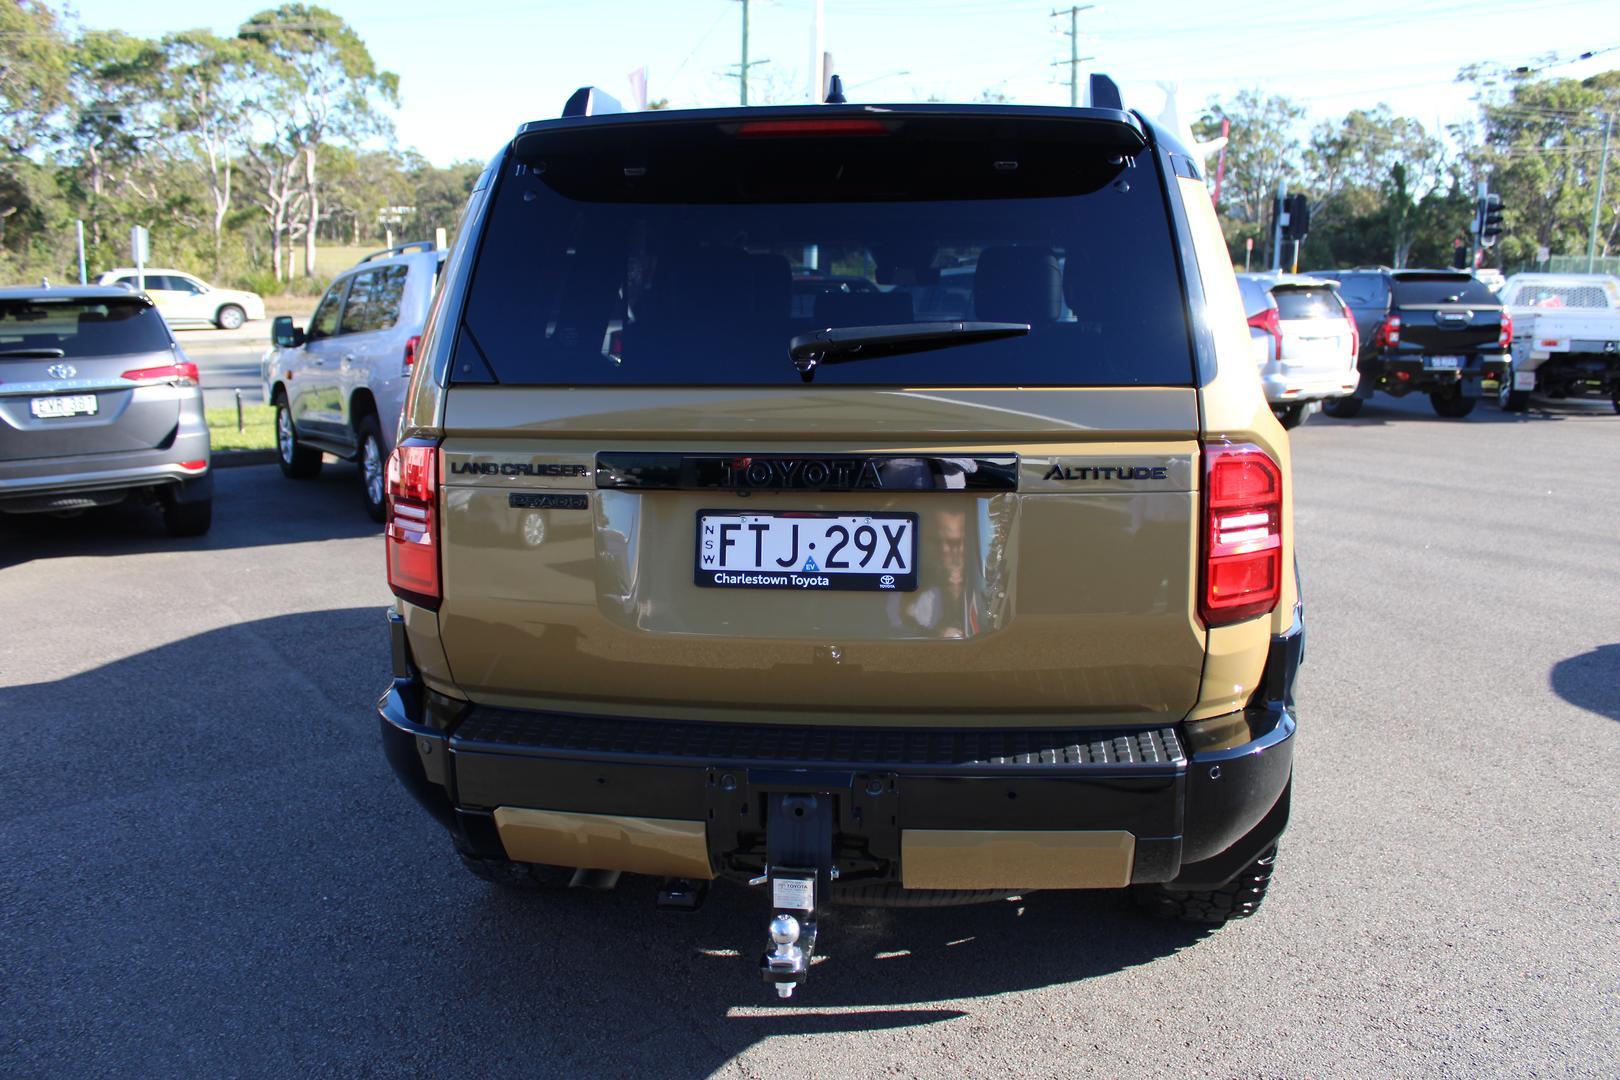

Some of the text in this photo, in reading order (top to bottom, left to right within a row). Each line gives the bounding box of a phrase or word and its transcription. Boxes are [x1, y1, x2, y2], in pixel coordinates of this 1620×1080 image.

[720, 458, 883, 488] TOYOTA
[1042, 464, 1169, 481] ALTITUDE
[714, 573, 829, 587] Charlestown Toyota
